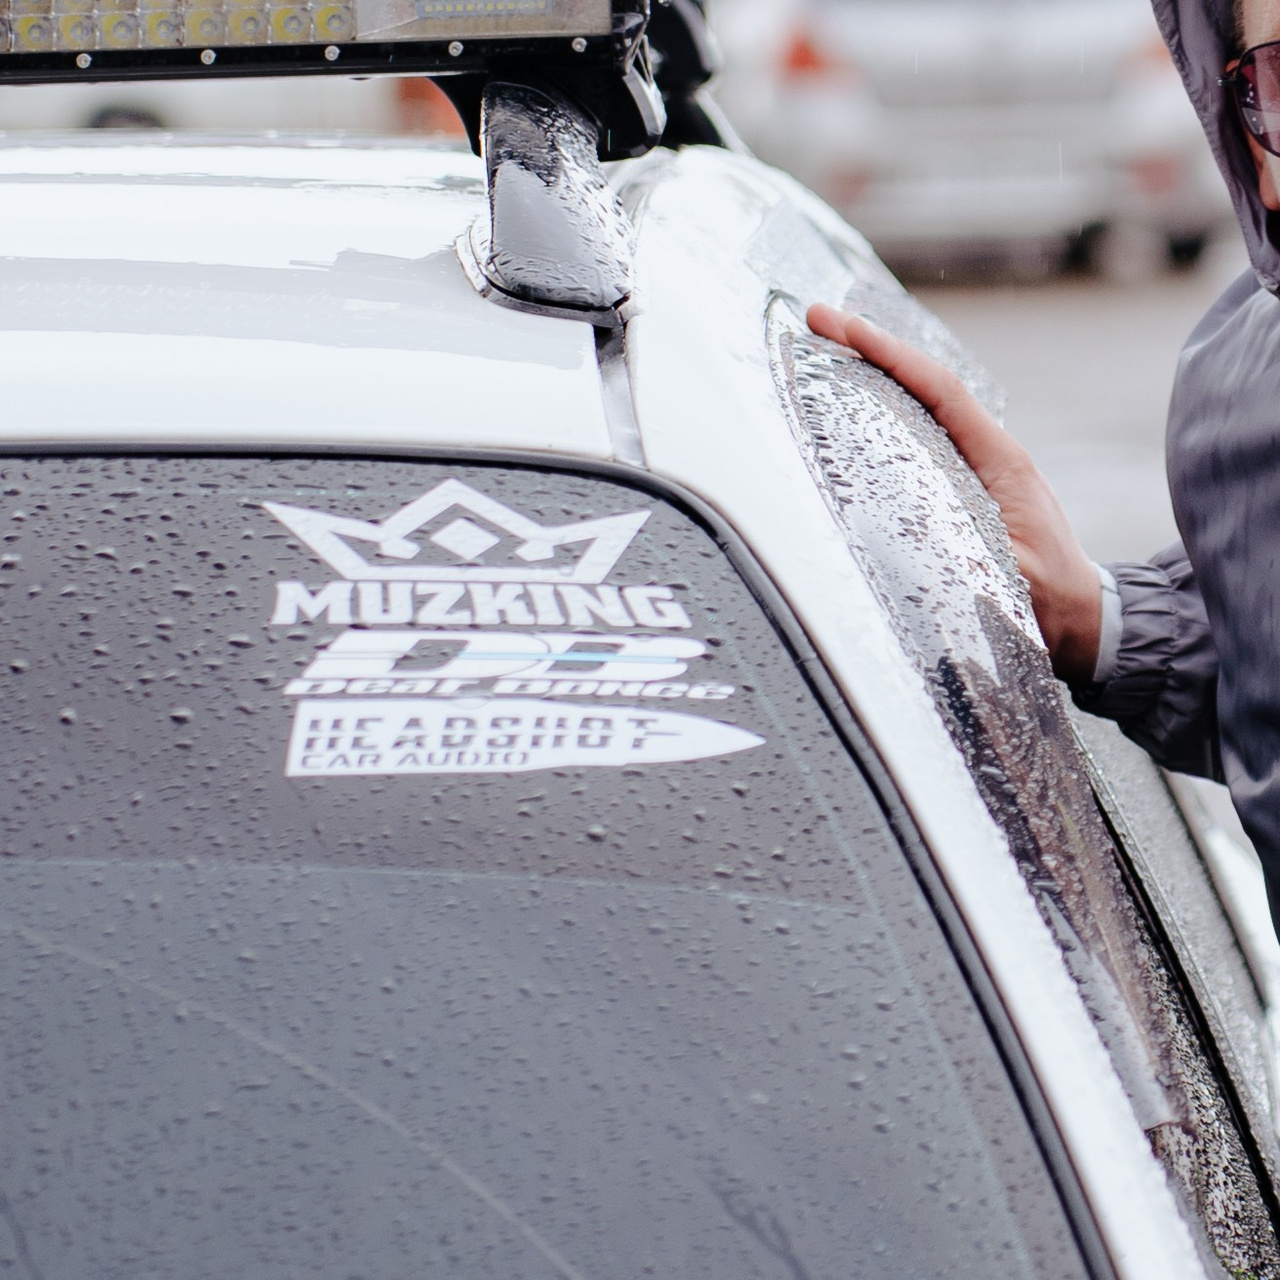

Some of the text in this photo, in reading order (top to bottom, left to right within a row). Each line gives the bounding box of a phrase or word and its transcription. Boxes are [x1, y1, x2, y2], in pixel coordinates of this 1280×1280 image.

[271, 581, 692, 628] MUZKING
[303, 716, 660, 751] HEADSHOT
[301, 750, 530, 769] CAR AUDIO
